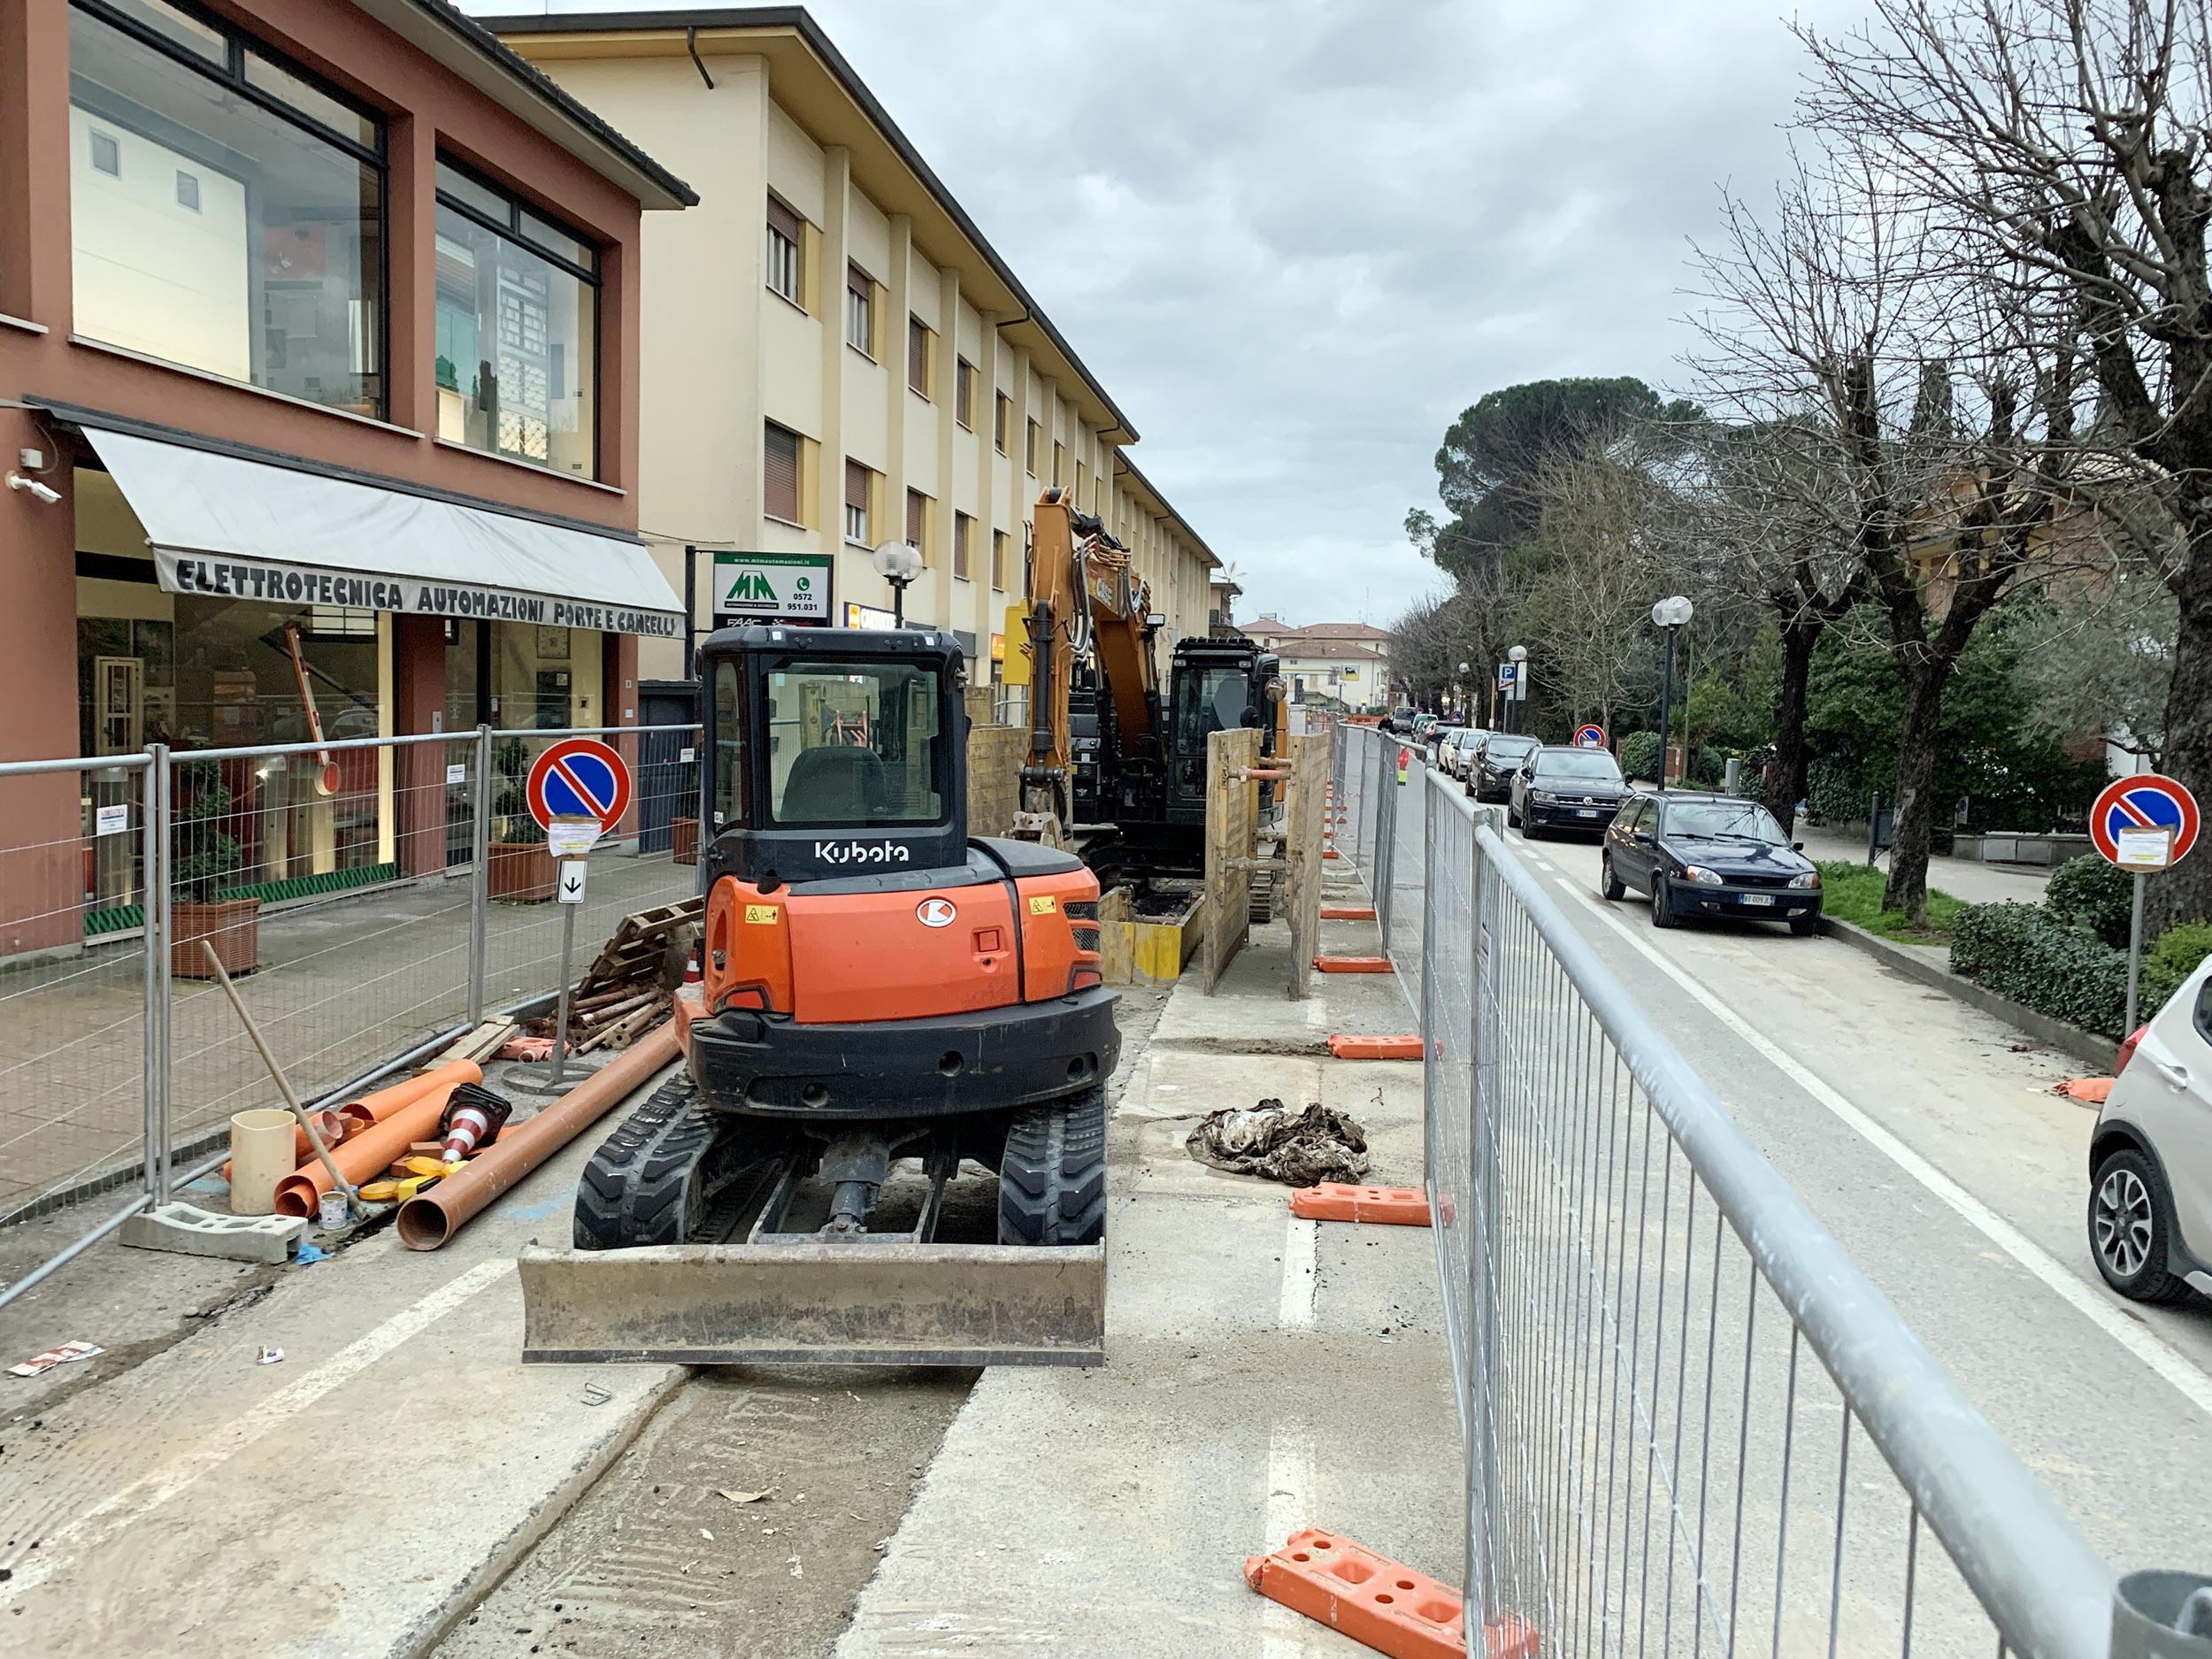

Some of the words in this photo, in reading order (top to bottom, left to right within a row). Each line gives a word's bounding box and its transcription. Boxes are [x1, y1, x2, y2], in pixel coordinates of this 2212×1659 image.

[177, 559, 403, 611] ELETTROTECNICA
[418, 587, 544, 623] AUTOMAZIONI
[554, 603, 602, 629] PORTE
[606, 612, 613, 629] E
[726, 618, 762, 626] FAAC
[1504, 667, 1512, 678] P
[815, 840, 909, 864] Kubota
